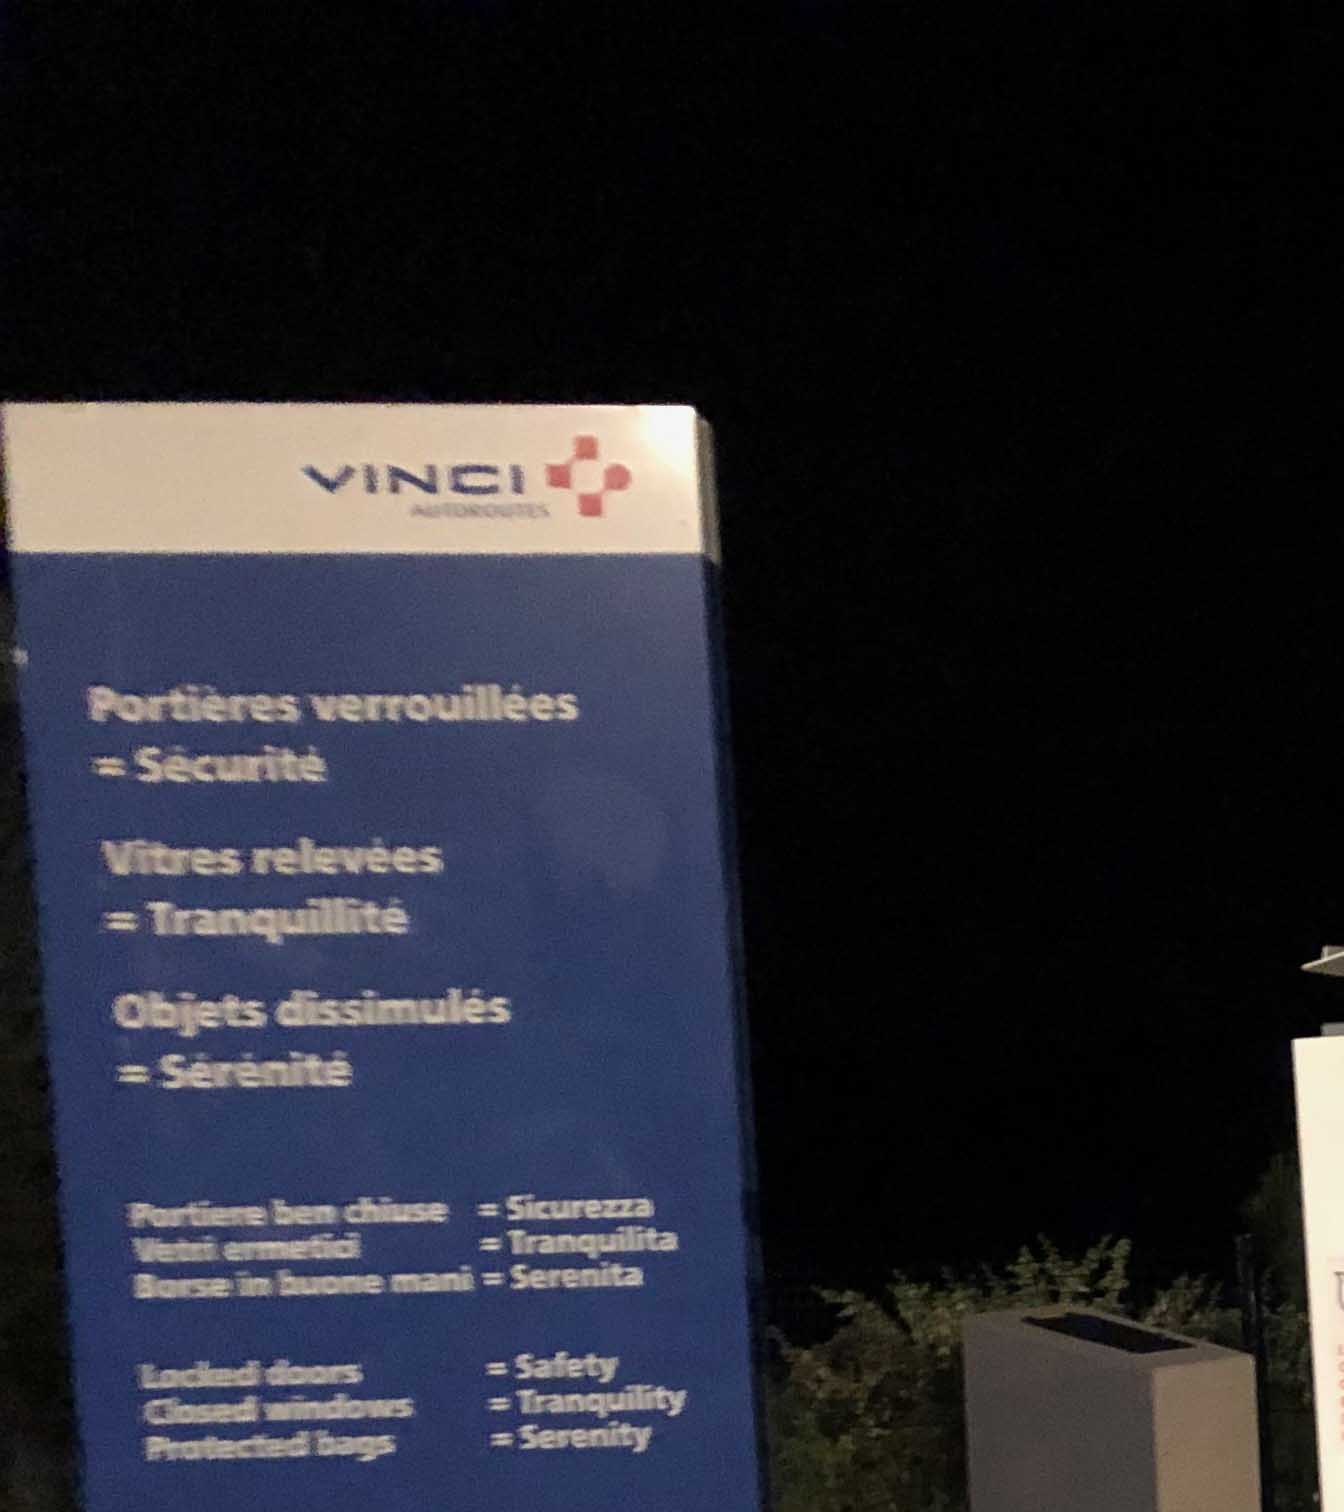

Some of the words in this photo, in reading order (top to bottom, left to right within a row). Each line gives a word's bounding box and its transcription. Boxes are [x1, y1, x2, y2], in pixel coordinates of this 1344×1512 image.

[300, 464, 525, 494] VINCI
[88, 685, 299, 723] Portières
[309, 684, 579, 722] verrouillées
[133, 746, 327, 782] Sécurité
[101, 839, 243, 876] Vitres
[251, 836, 444, 875] relevées
[112, 990, 268, 1038] Objets
[274, 988, 512, 1026] dissimulés
[159, 1051, 353, 1089] Sérénité
[505, 1194, 656, 1221] Sicurezza
[389, 1264, 476, 1294] mani
[508, 1261, 645, 1290] Serenita
[513, 1351, 620, 1384] Safety
[514, 1384, 689, 1419] Tranquility
[517, 1421, 653, 1453] Serenity
